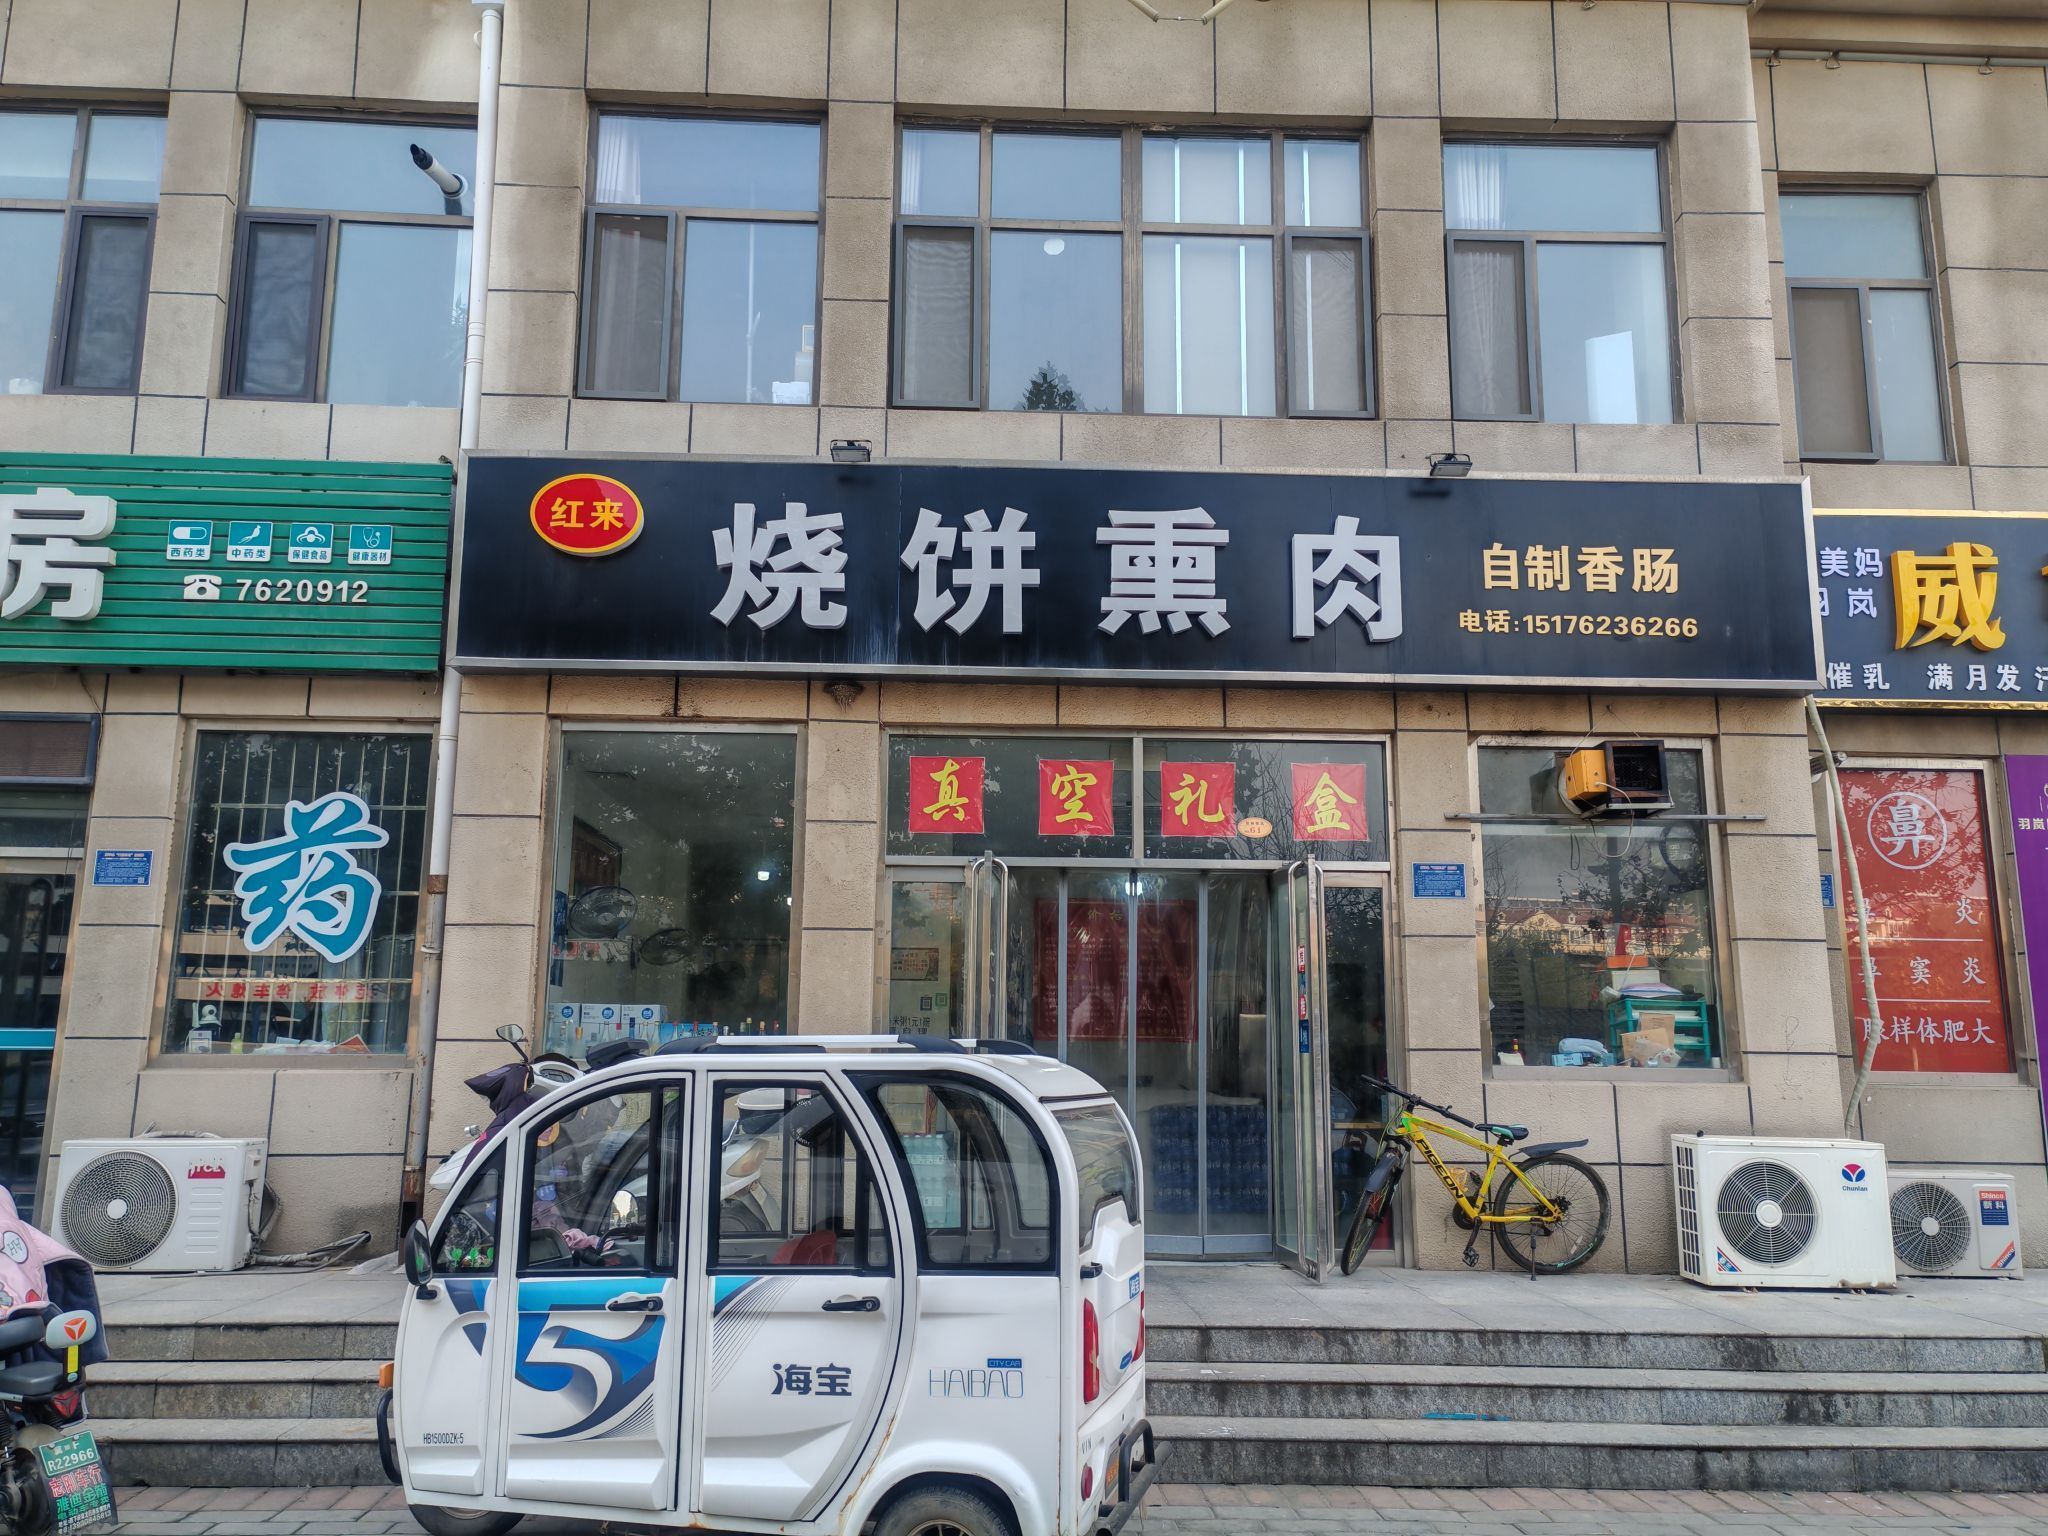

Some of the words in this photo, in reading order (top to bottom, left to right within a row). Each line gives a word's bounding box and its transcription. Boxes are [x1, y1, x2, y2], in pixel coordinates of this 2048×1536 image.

[550, 496, 625, 530] 红来
[0, 487, 117, 621] 房
[170, 546, 206, 558] 西药类
[231, 547, 267, 559] 中药类
[292, 549, 328, 561] 保健食品
[352, 551, 388, 562] 健康器材
[1483, 543, 1680, 594] 自制香肠
[709, 501, 1404, 644] 烧饼熏肉
[236, 578, 369, 603] 7620912
[1891, 541, 2006, 652] 威
[1826, 662, 1890, 690] 催乳
[923, 758, 1358, 834] 真空礼盒
[1880, 798, 1935, 858] 鼻
[2018, 818, 2048, 830] 羽岚
[223, 791, 390, 963] 药
[1416, 1138, 1464, 1199] PIGEON
[771, 1362, 852, 1396] 海宝
[929, 1369, 1024, 1398] HAIBAO
[47, 1447, 95, 1473] R22966
